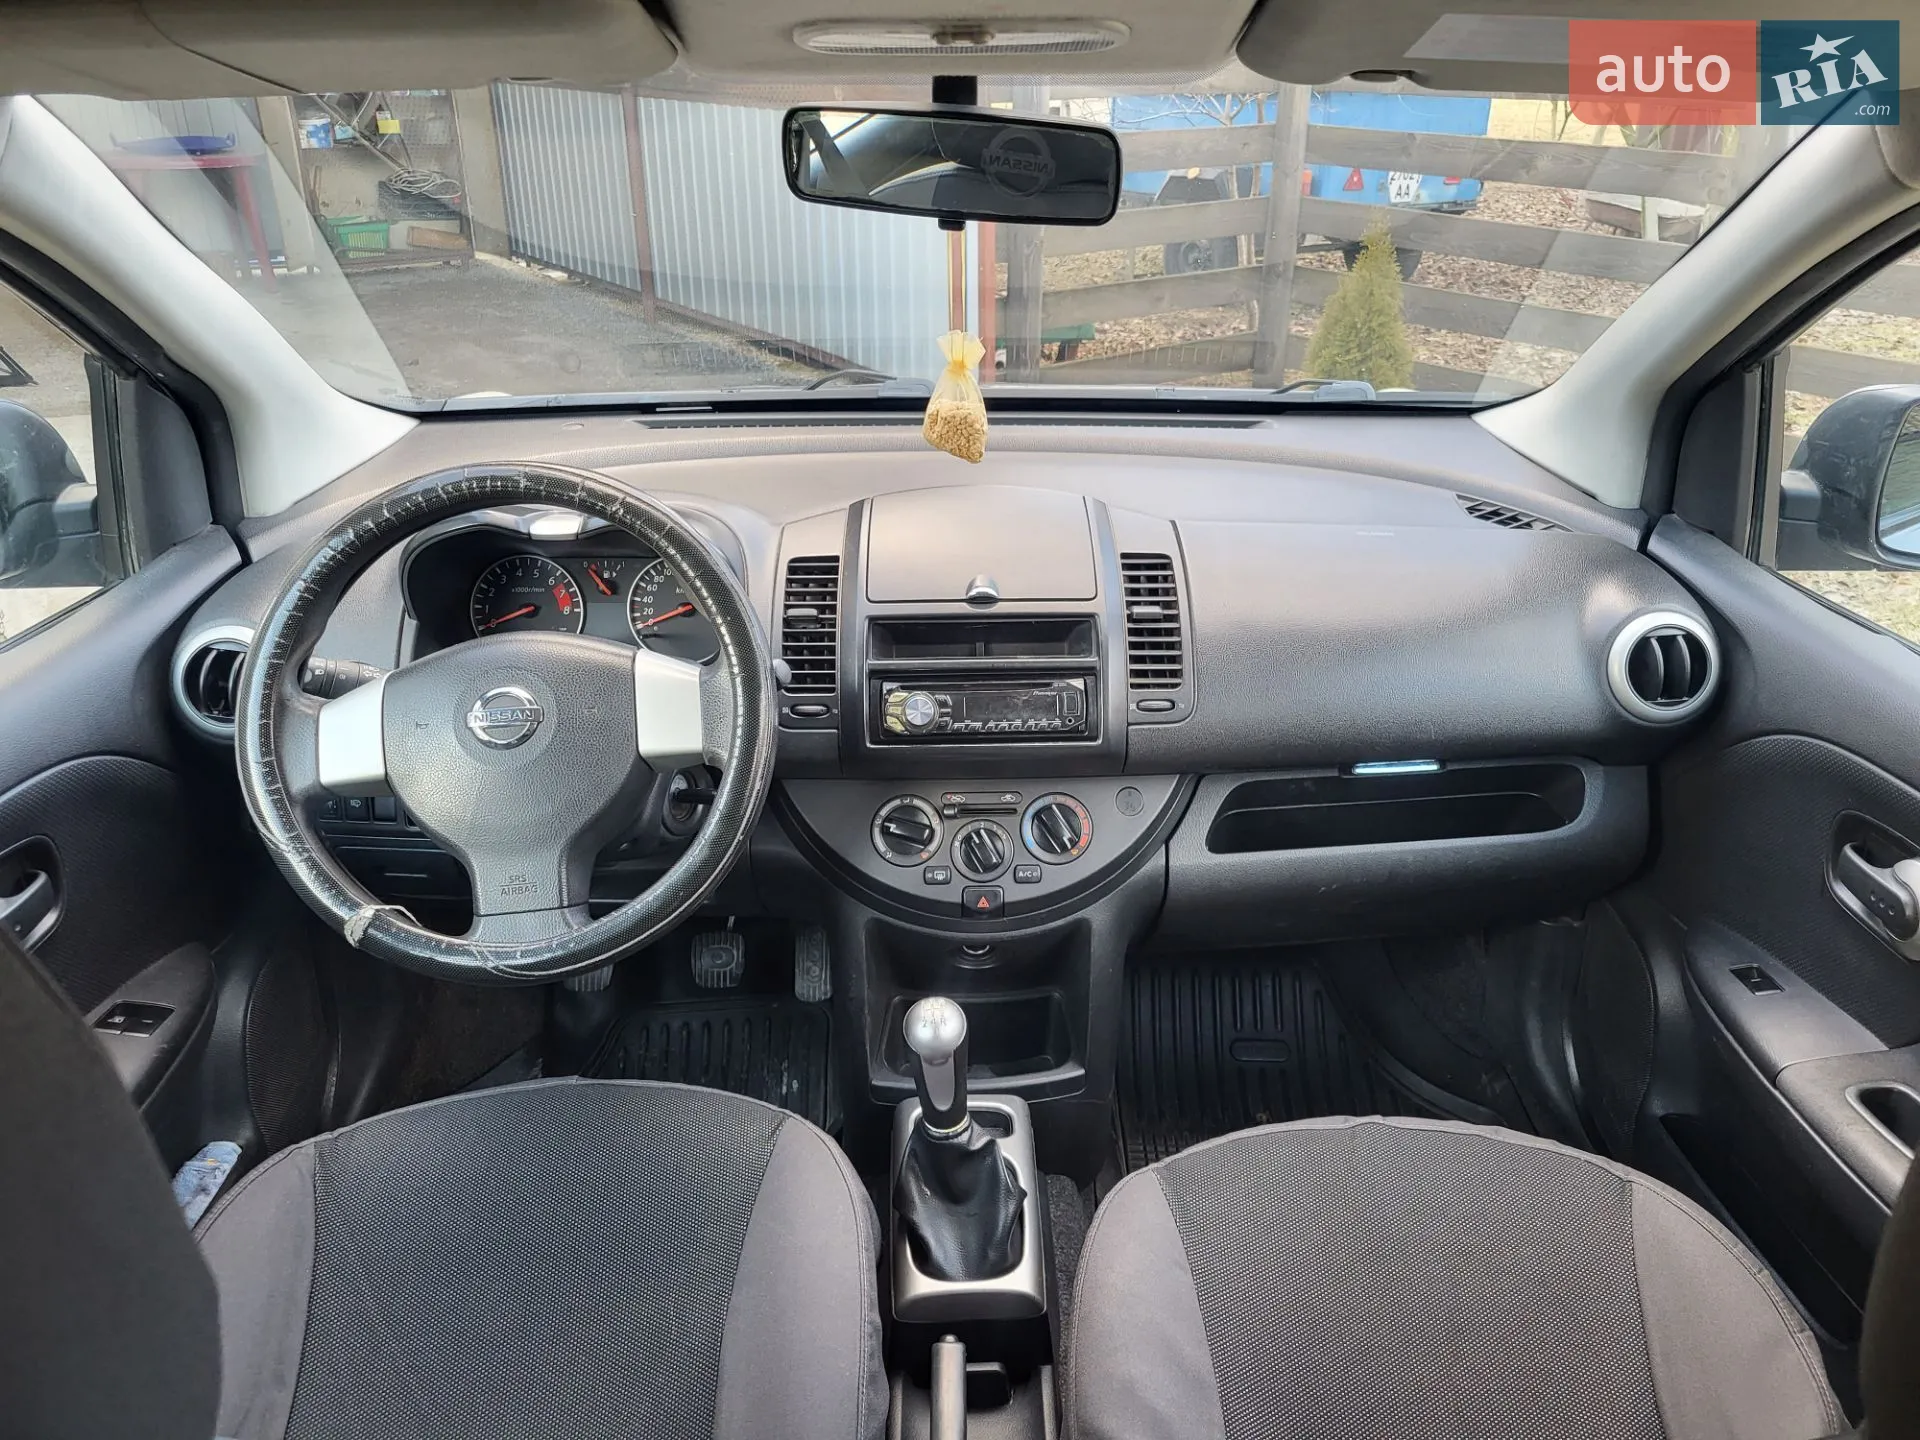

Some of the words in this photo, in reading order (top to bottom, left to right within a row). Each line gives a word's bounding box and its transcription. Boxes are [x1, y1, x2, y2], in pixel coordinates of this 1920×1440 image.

[515, 568, 522, 576] 4
[533, 569, 540, 578] 5
[500, 575, 507, 584] 3
[548, 576, 555, 585] 6
[653, 575, 665, 583] 80
[488, 587, 495, 597] 2
[646, 584, 658, 592] 60
[559, 589, 566, 598] 7
[563, 605, 570, 615] 8
[643, 607, 654, 615] 20
[473, 709, 536, 724] NISSAN
[1018, 870, 1032, 878] A/C
[508, 874, 527, 884] SRS
[500, 884, 538, 897] AIRBAG
